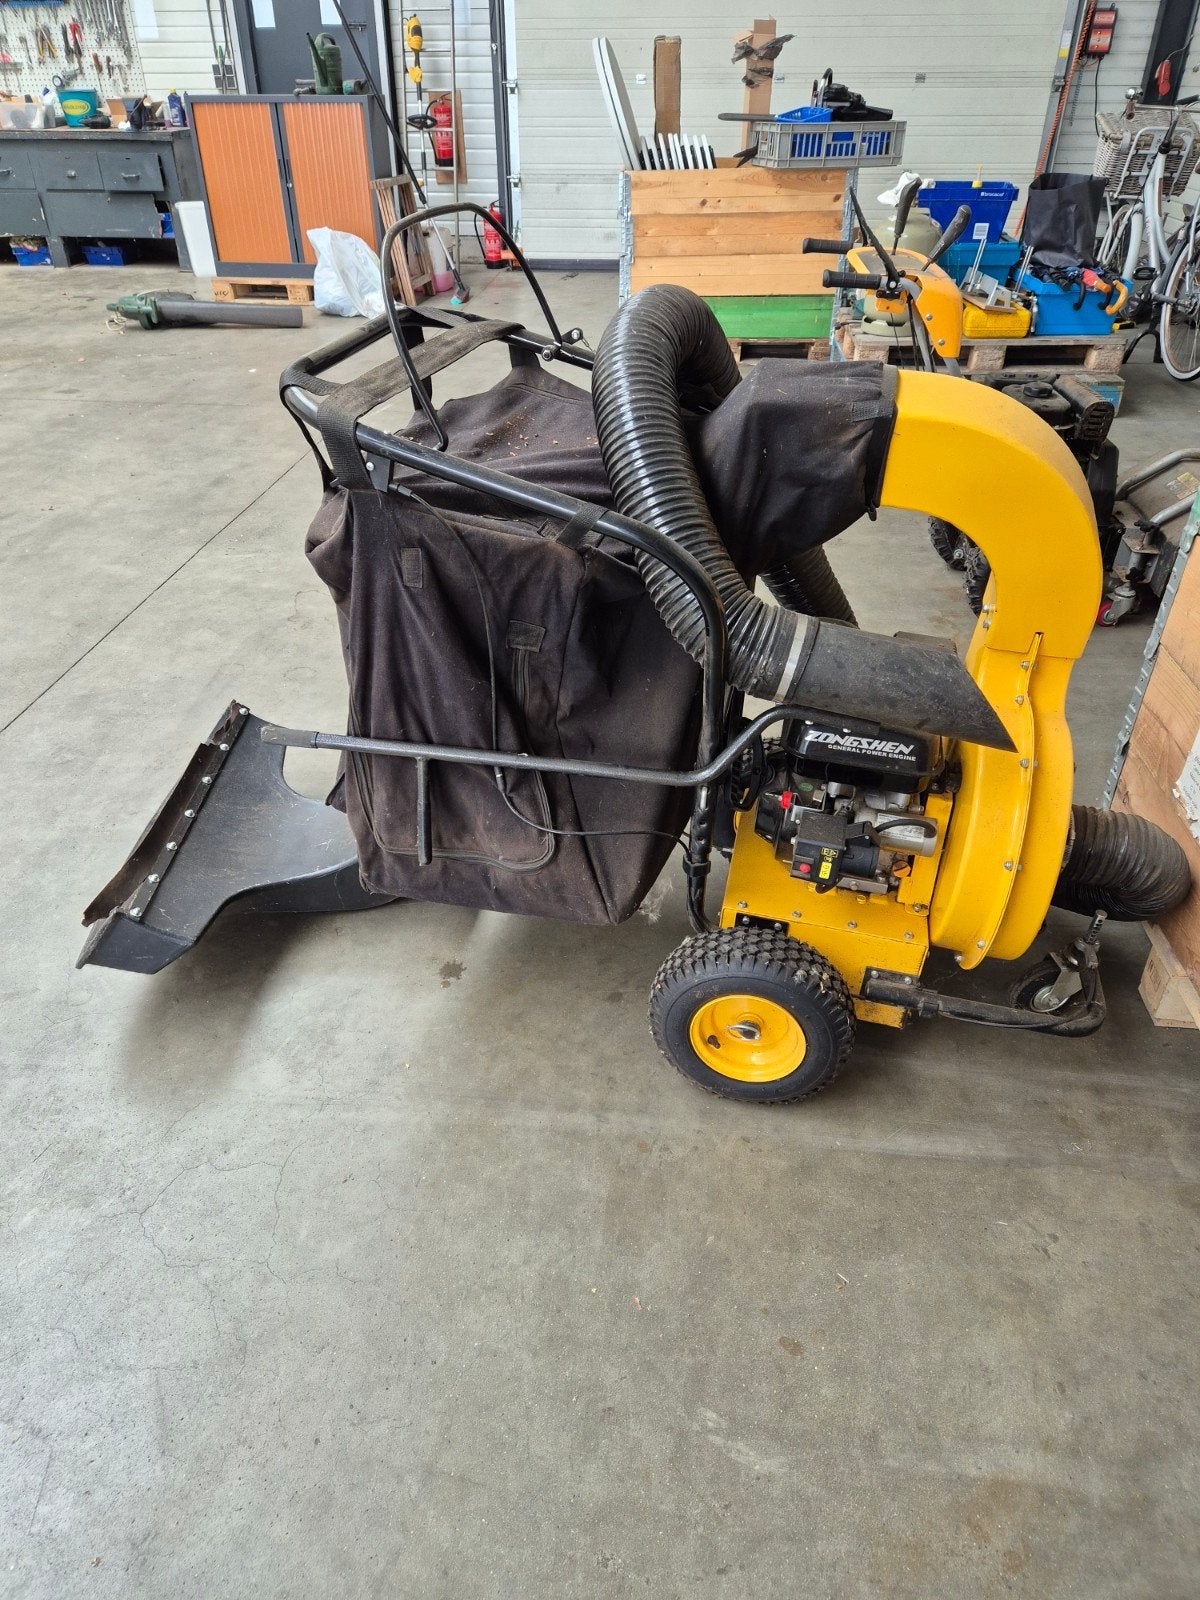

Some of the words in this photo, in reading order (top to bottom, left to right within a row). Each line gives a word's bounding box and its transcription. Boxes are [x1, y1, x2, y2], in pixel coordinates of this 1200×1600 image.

[804, 729, 915, 755] ZONGSHEN
[827, 744, 861, 754] GENERAL
[861, 749, 888, 758] POWER
[888, 753, 917, 762] ENGINE
